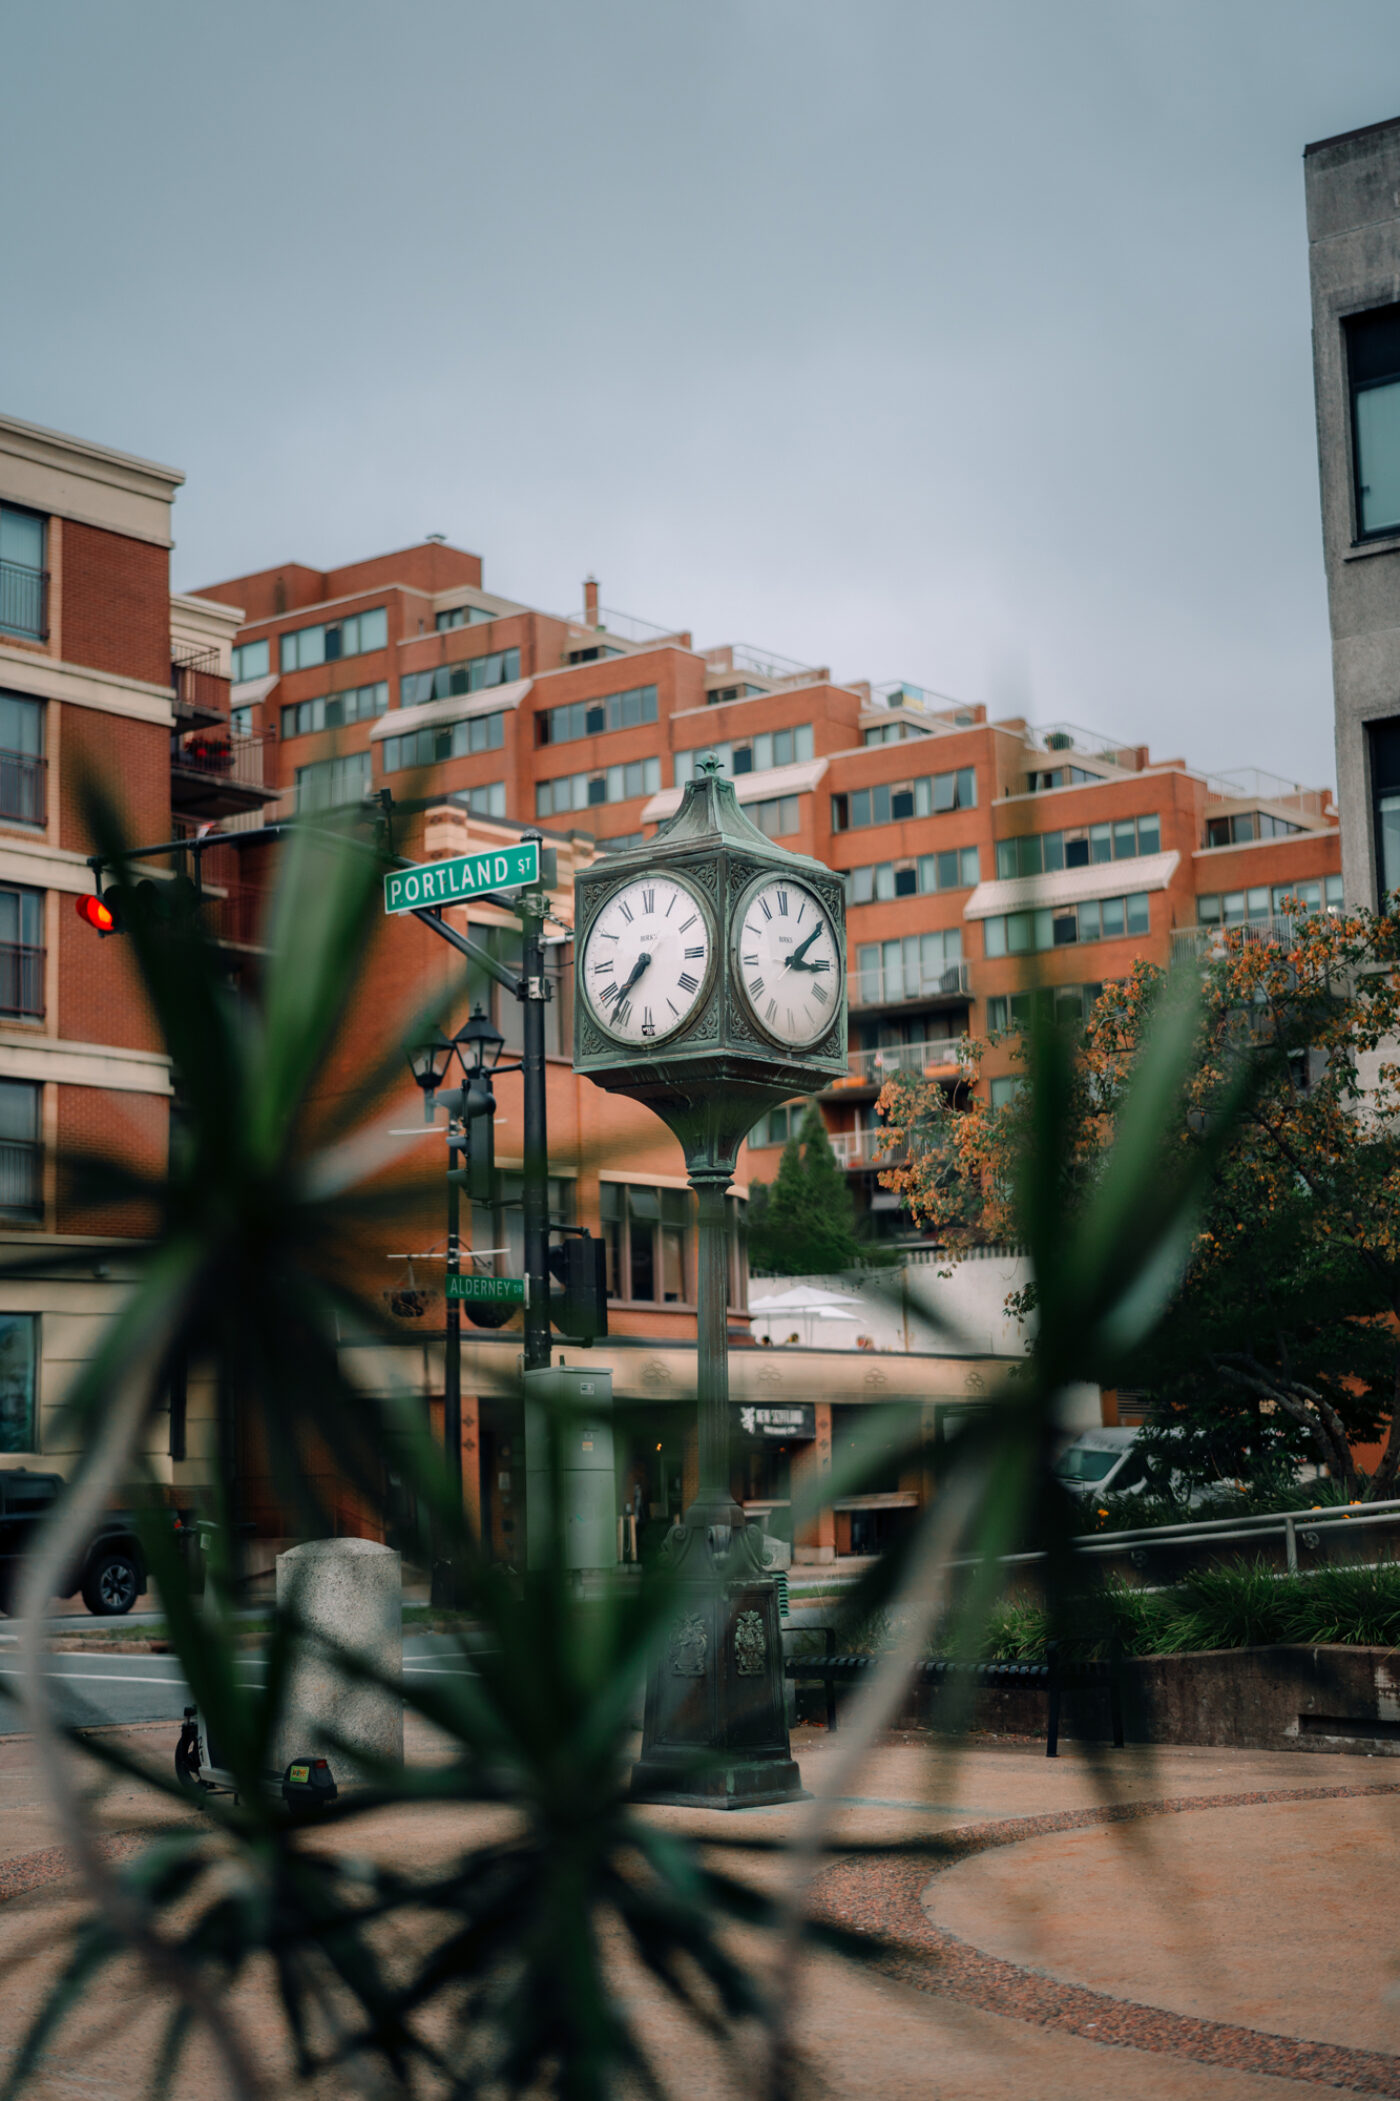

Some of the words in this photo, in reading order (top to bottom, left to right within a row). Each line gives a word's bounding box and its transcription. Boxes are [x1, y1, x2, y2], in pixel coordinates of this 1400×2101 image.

[391, 856, 508, 905] PORTLAND
[517, 857, 531, 873] ST
[450, 1278, 511, 1297] ALDERNEY
